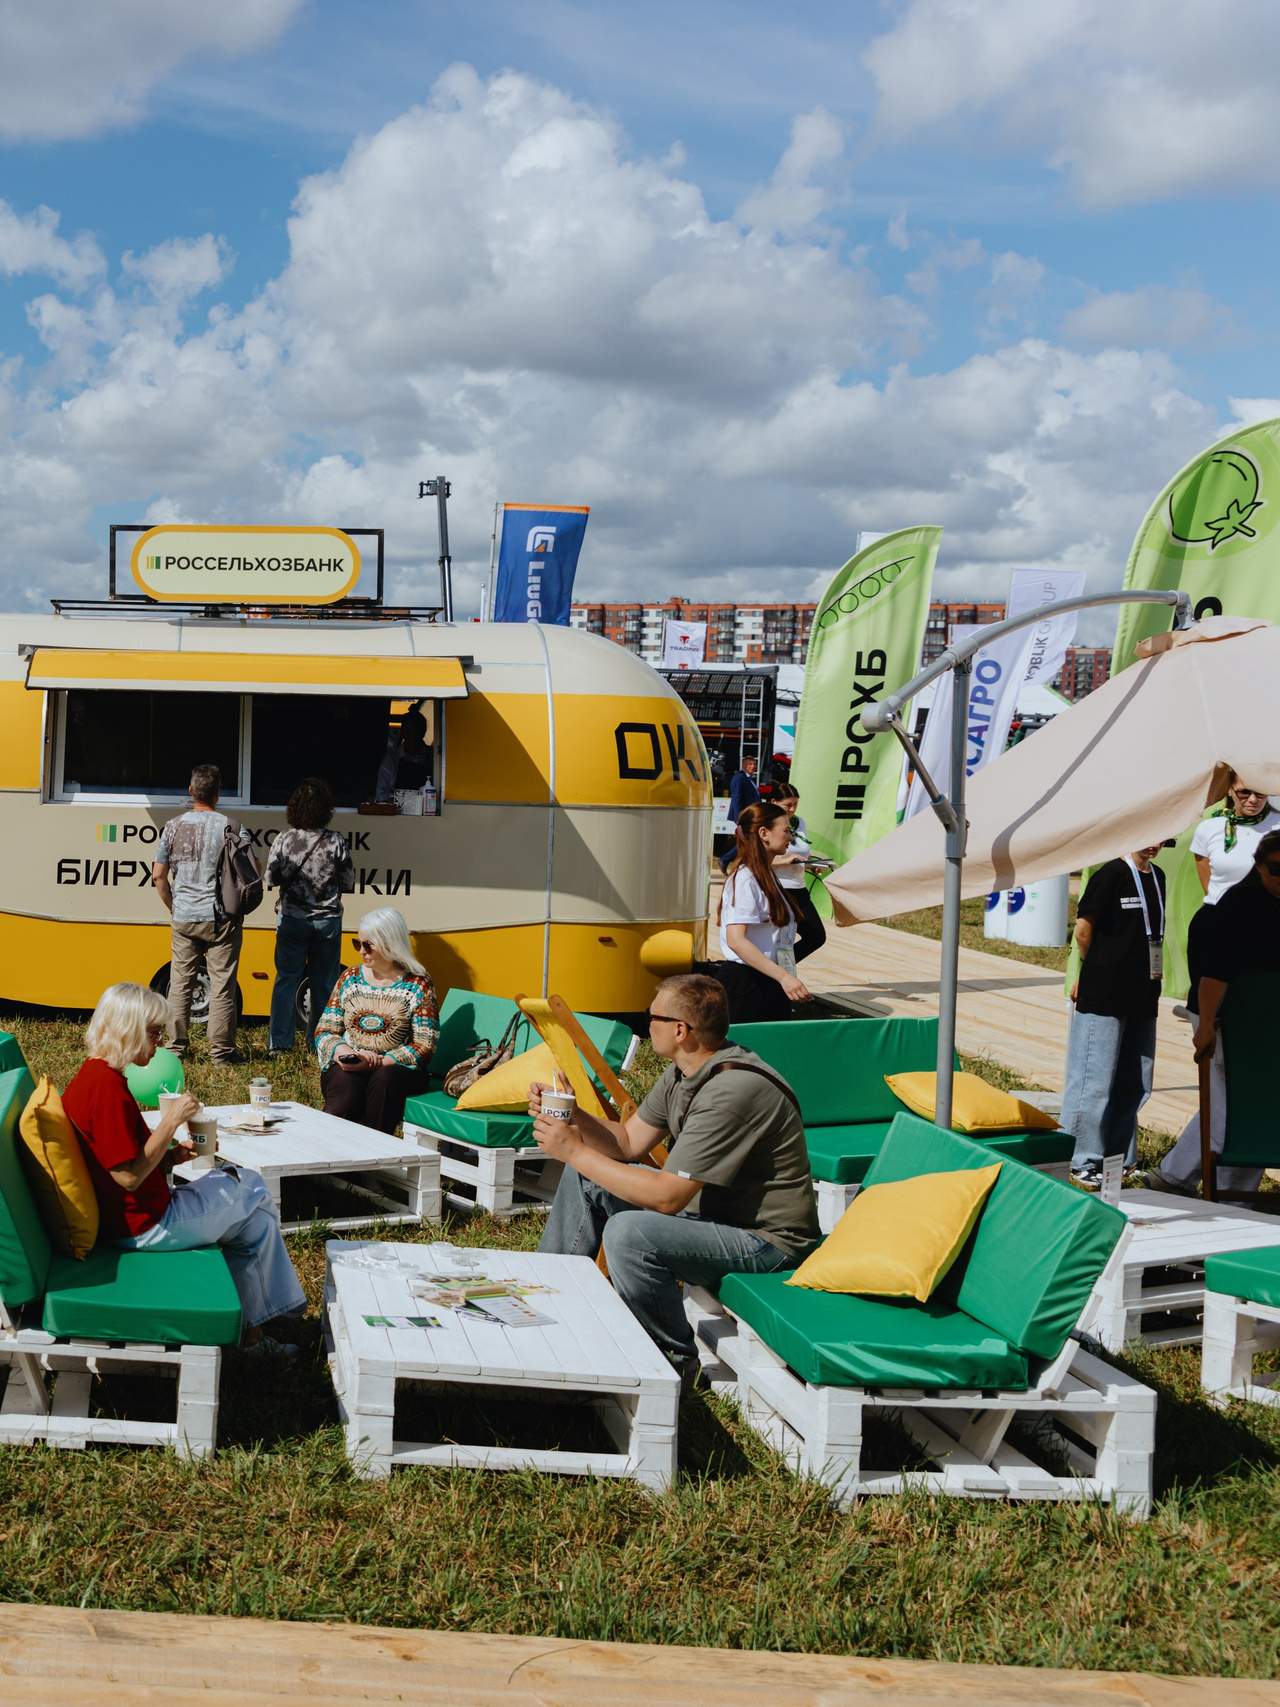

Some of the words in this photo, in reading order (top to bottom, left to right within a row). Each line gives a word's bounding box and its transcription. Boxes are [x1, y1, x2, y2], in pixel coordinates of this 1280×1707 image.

[165, 556, 344, 573] РОССЕЛЬХОЗБАНК
[966, 660, 1002, 777] САГРО
[615, 722, 708, 782] ОК
[57, 858, 157, 888] БИРЖ
